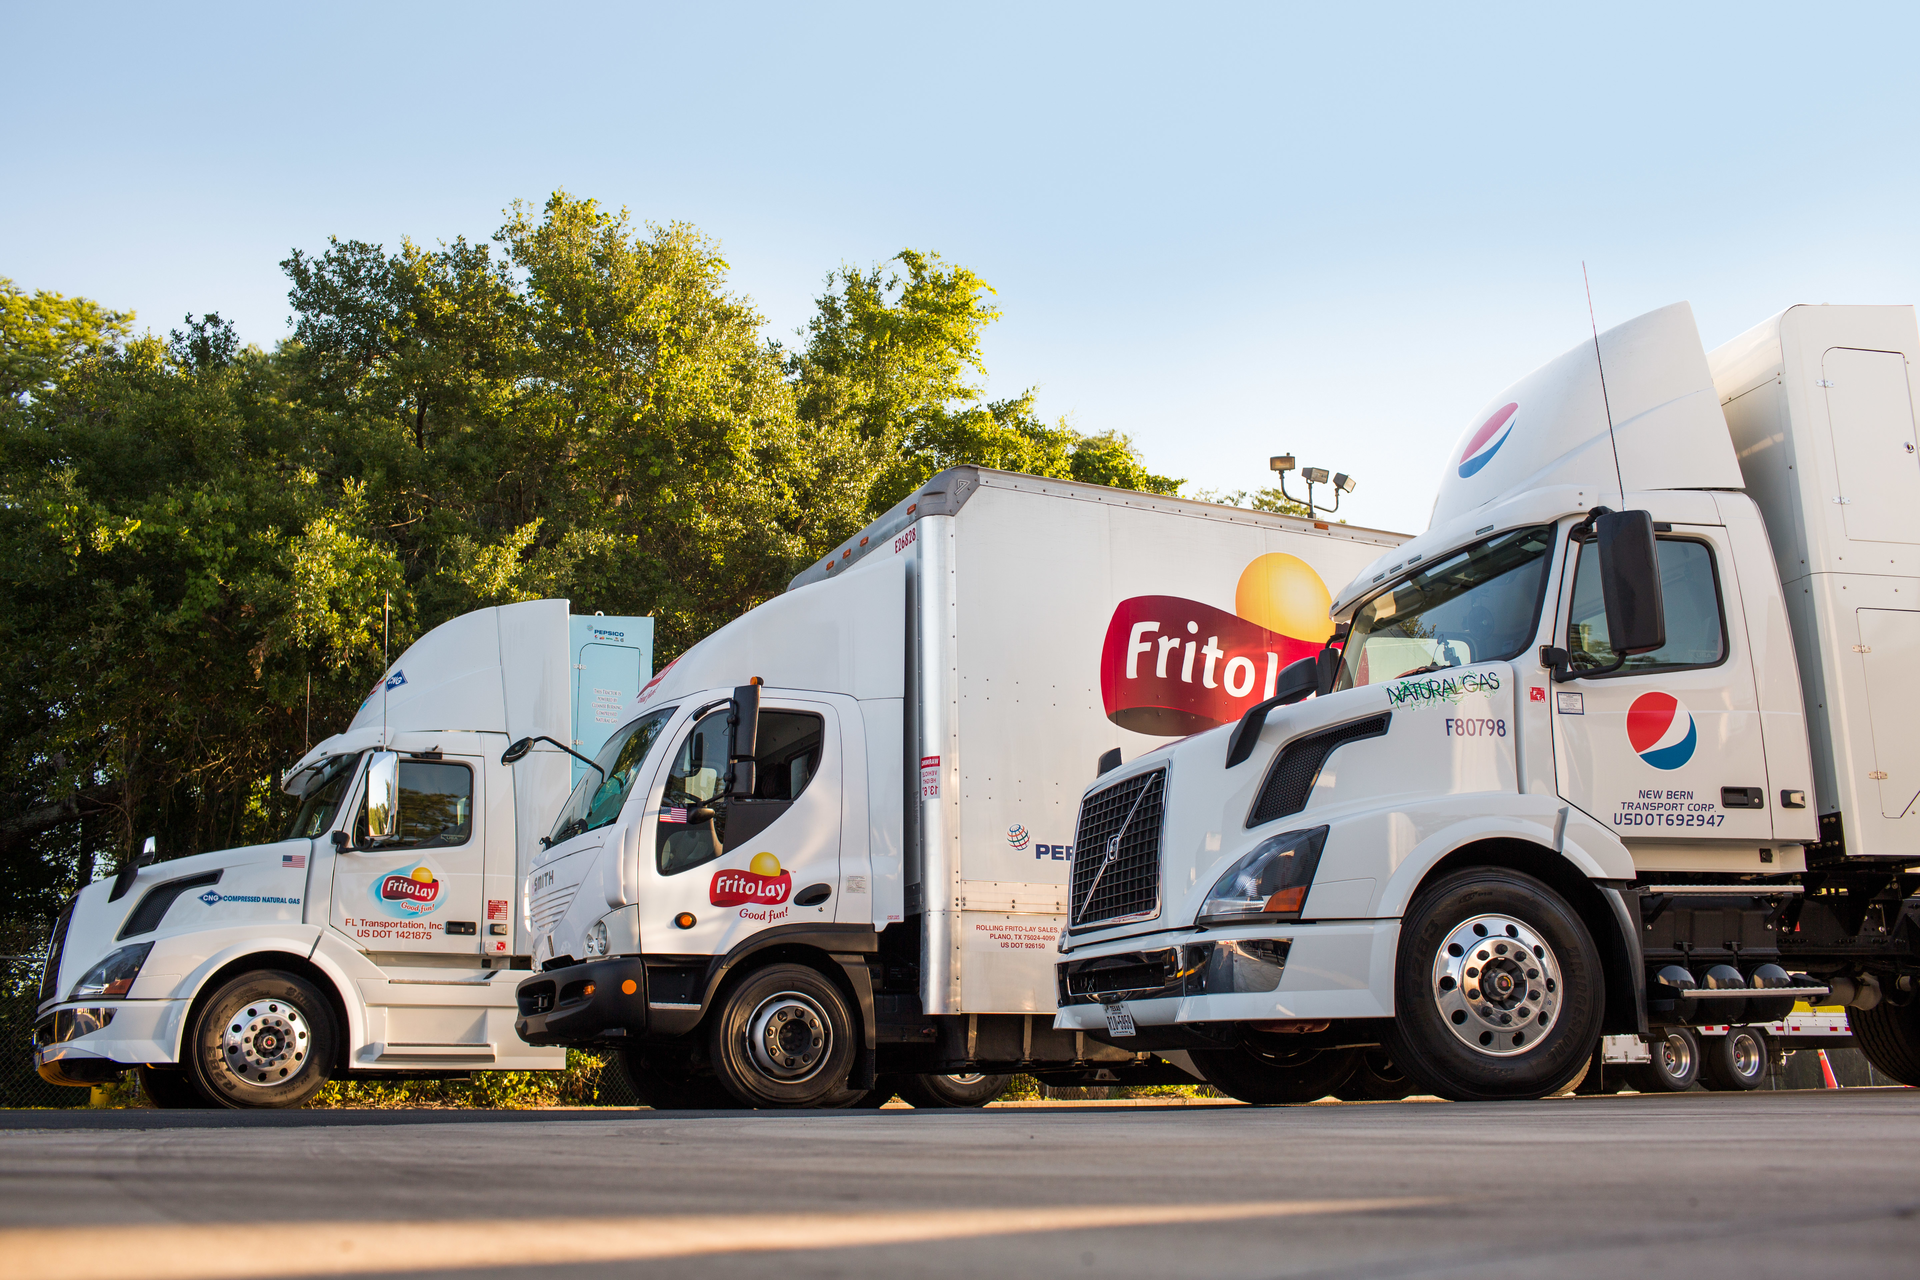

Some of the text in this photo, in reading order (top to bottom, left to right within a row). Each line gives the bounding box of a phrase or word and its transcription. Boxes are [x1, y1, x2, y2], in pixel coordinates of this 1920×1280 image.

[895, 527, 916, 554] E26828
[594, 629, 625, 637] PEPSICO
[1386, 671, 1500, 705] NATURAL GAS
[1445, 718, 1507, 738] F80798
[1638, 789, 1694, 800] NEW BERN
[1621, 801, 1717, 813] TRANSPORT CORP.
[1613, 813, 1725, 827] USDOT692947
[534, 870, 554, 893] SMITH
[222, 895, 260, 903] COMPRESSED
[401, 901, 435, 914] Good fun!
[739, 906, 789, 924] Good fun!
[345, 918, 444, 930] FL Transportation, Inc.
[357, 929, 432, 940] US DOT 1421875
